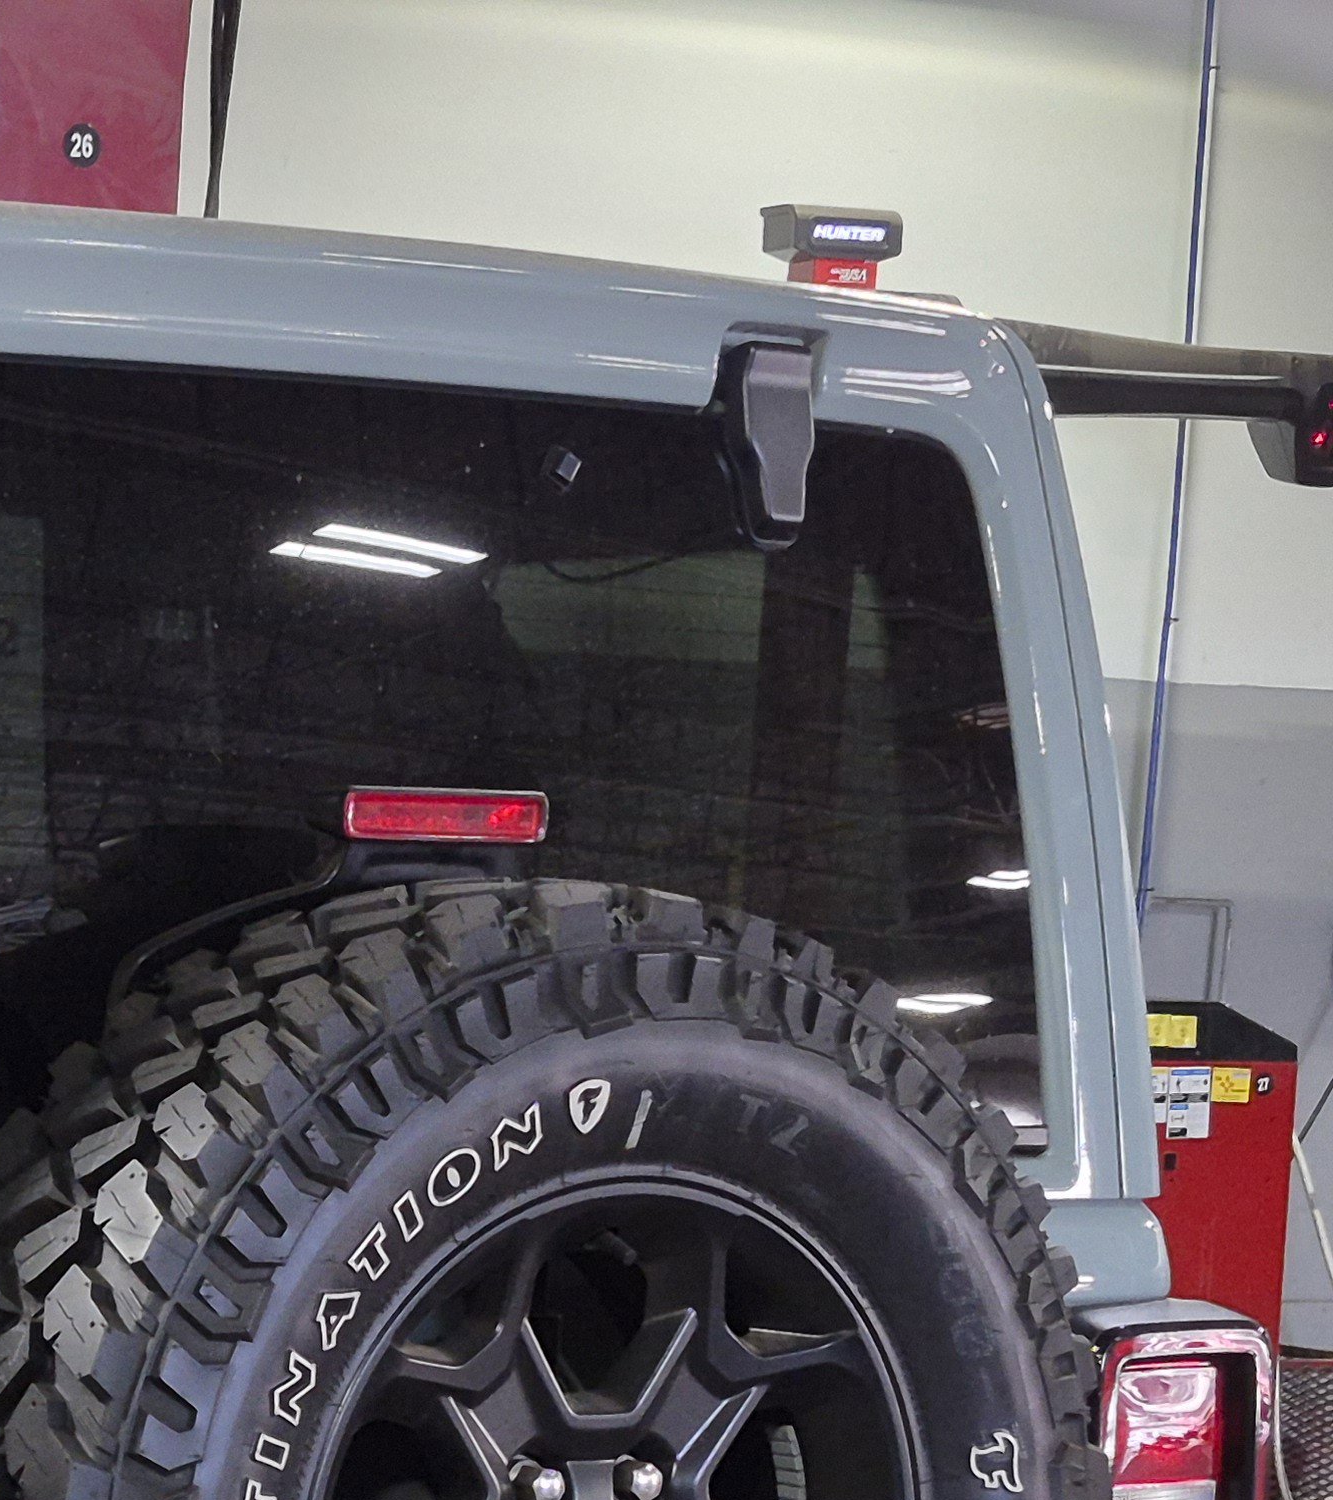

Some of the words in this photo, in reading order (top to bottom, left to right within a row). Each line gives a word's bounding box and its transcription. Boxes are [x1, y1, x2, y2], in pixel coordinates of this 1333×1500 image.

[70, 132, 93, 158] 26
[813, 224, 886, 242] HUNTER
[1257, 1077, 1270, 1092] 27
